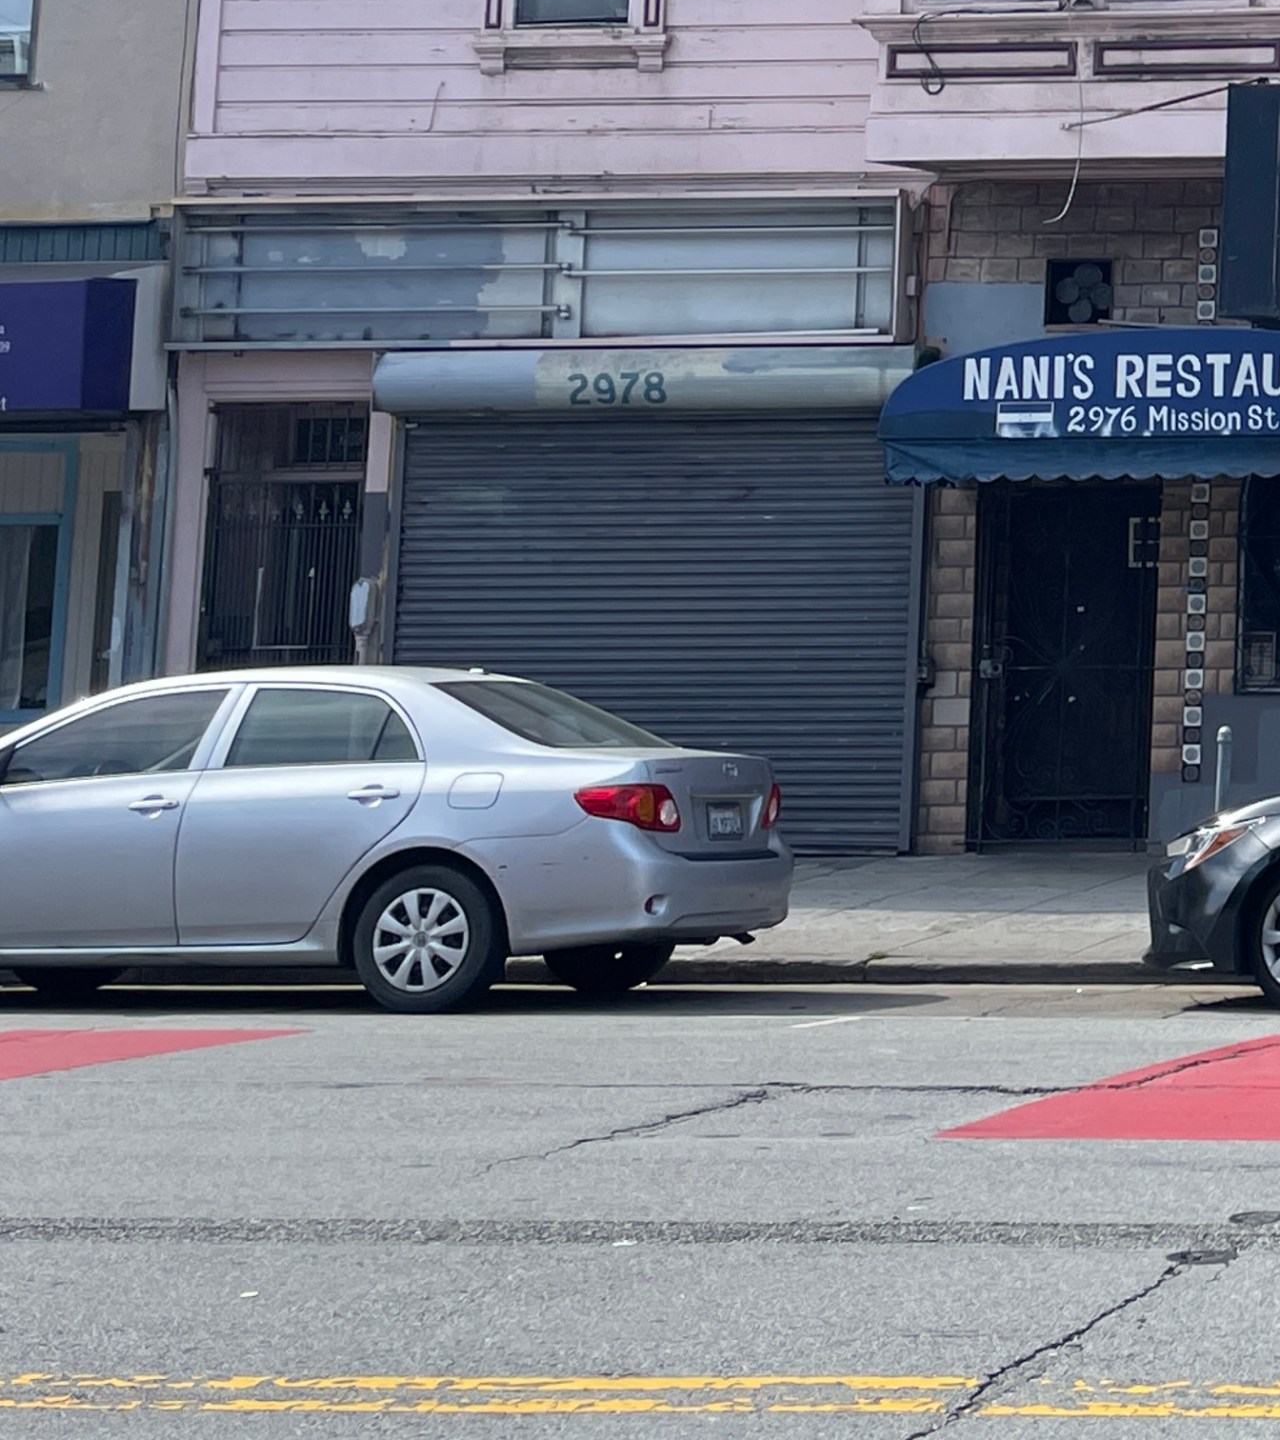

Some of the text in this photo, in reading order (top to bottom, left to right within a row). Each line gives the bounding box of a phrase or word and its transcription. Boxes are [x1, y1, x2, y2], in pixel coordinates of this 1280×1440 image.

[567, 371, 667, 405] 2978
[963, 354, 1095, 400] NANI'S
[1066, 406, 1138, 432] 2976
[1148, 406, 1241, 432] Mission
[1247, 405, 1280, 431] St
